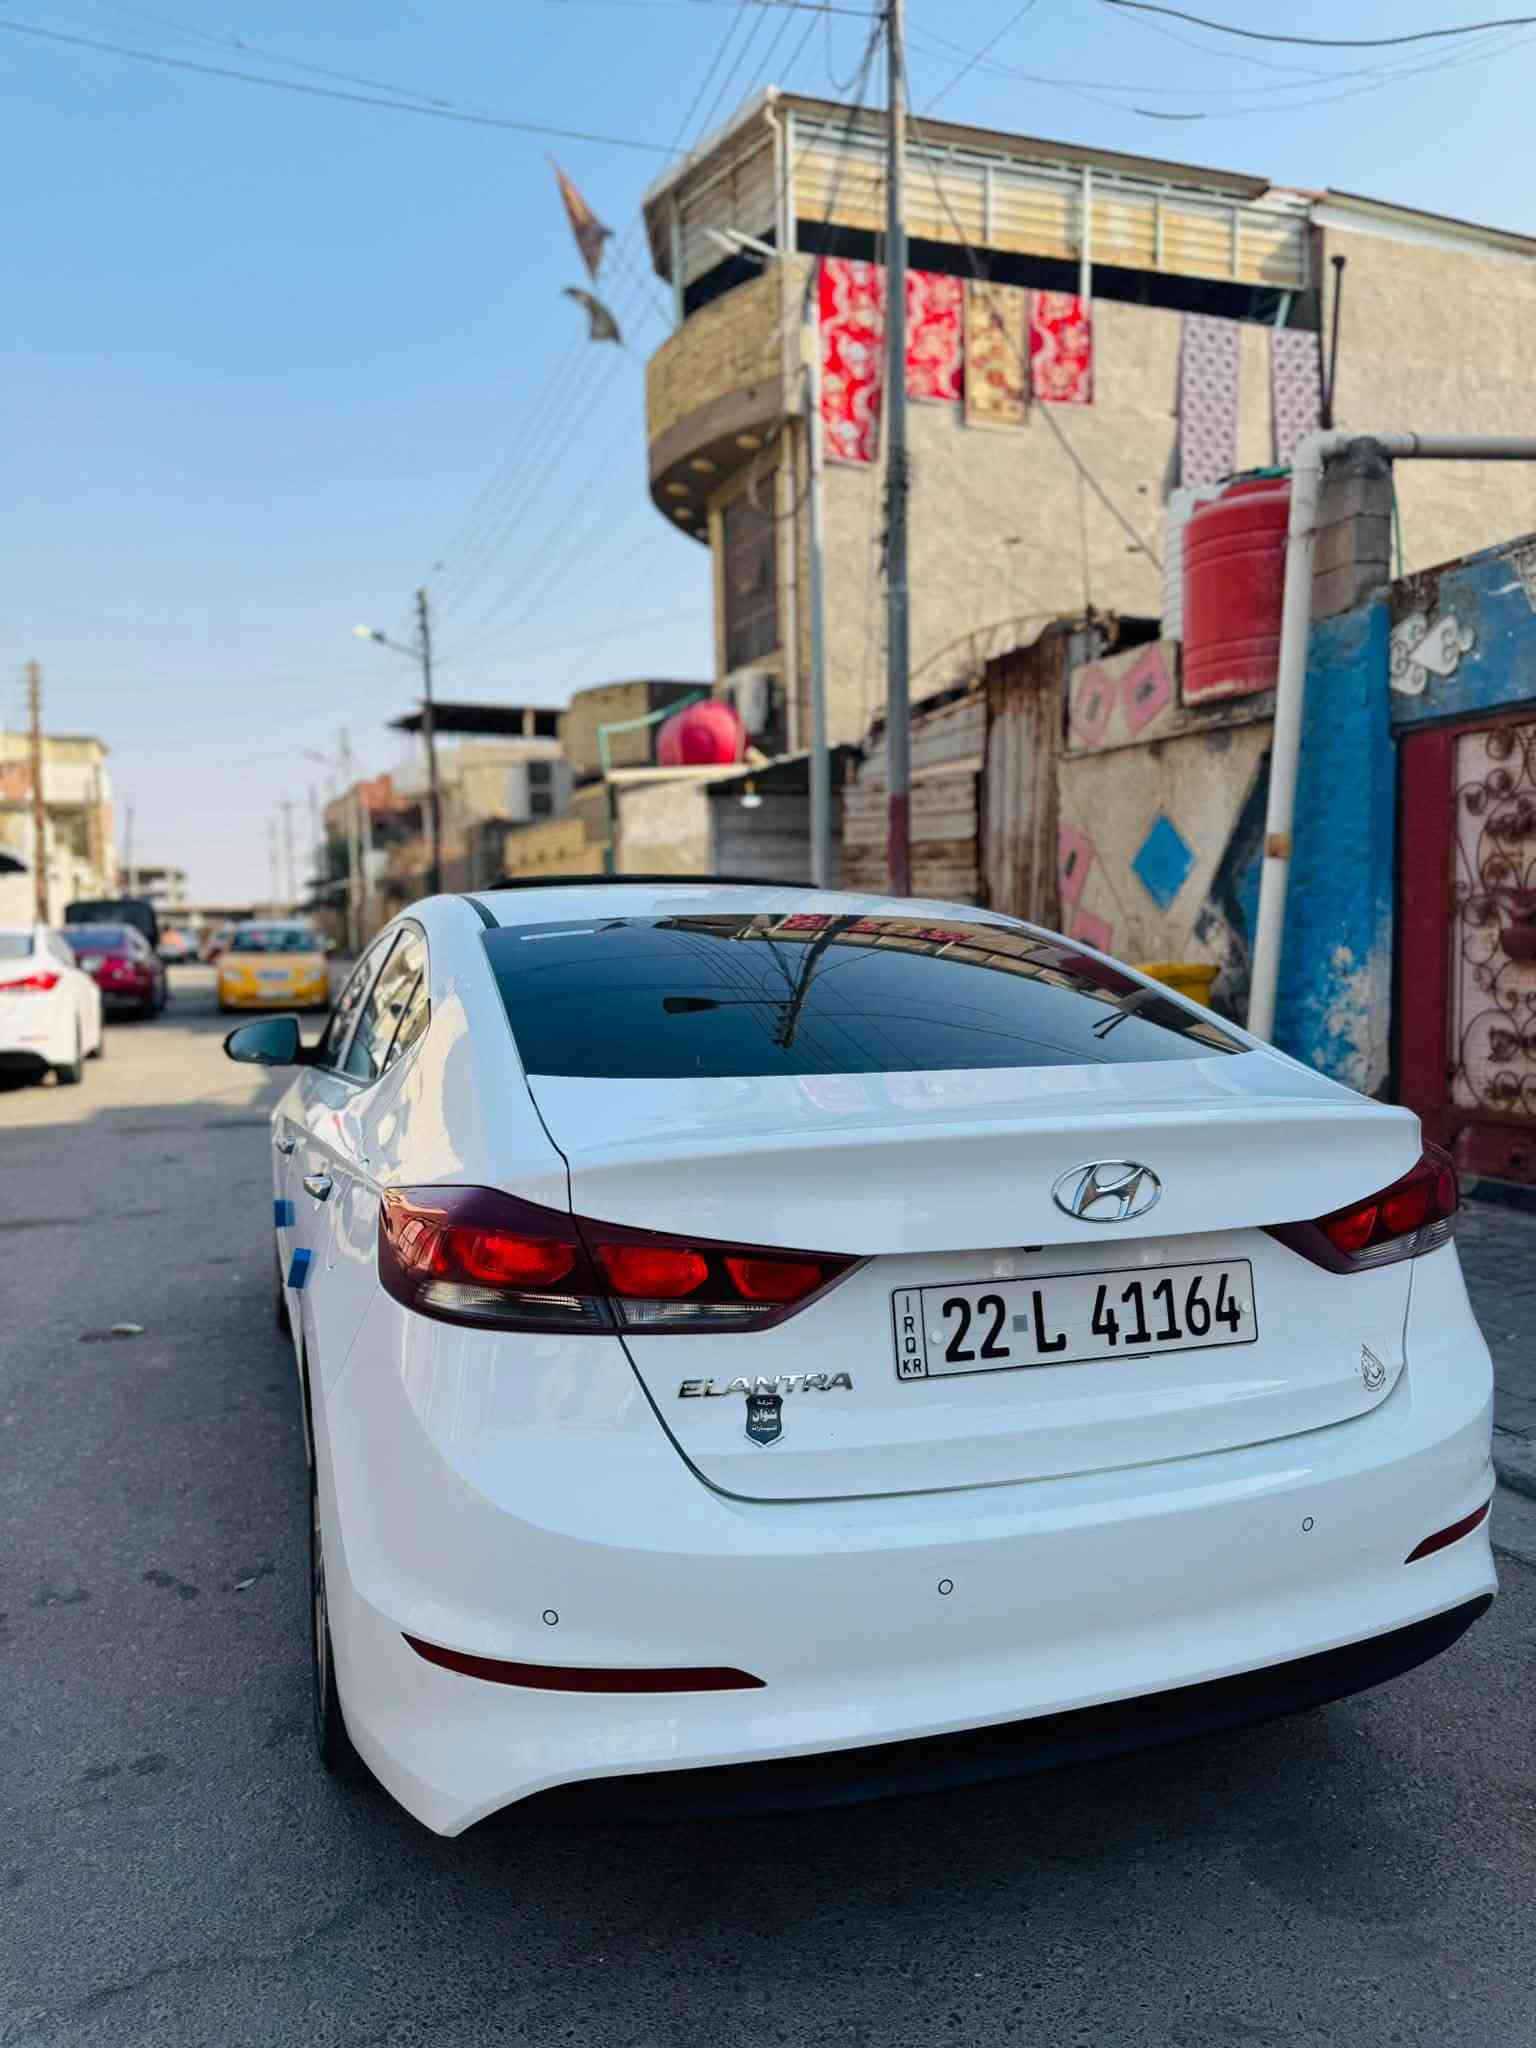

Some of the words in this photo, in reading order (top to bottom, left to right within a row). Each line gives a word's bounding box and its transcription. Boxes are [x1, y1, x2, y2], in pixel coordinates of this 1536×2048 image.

[942, 1294, 1010, 1362] 22
[1032, 1290, 1067, 1352] L
[1091, 1273, 1241, 1346] 41164
[902, 1358, 922, 1373] KR
[678, 1372, 854, 1398] ELANTRA
